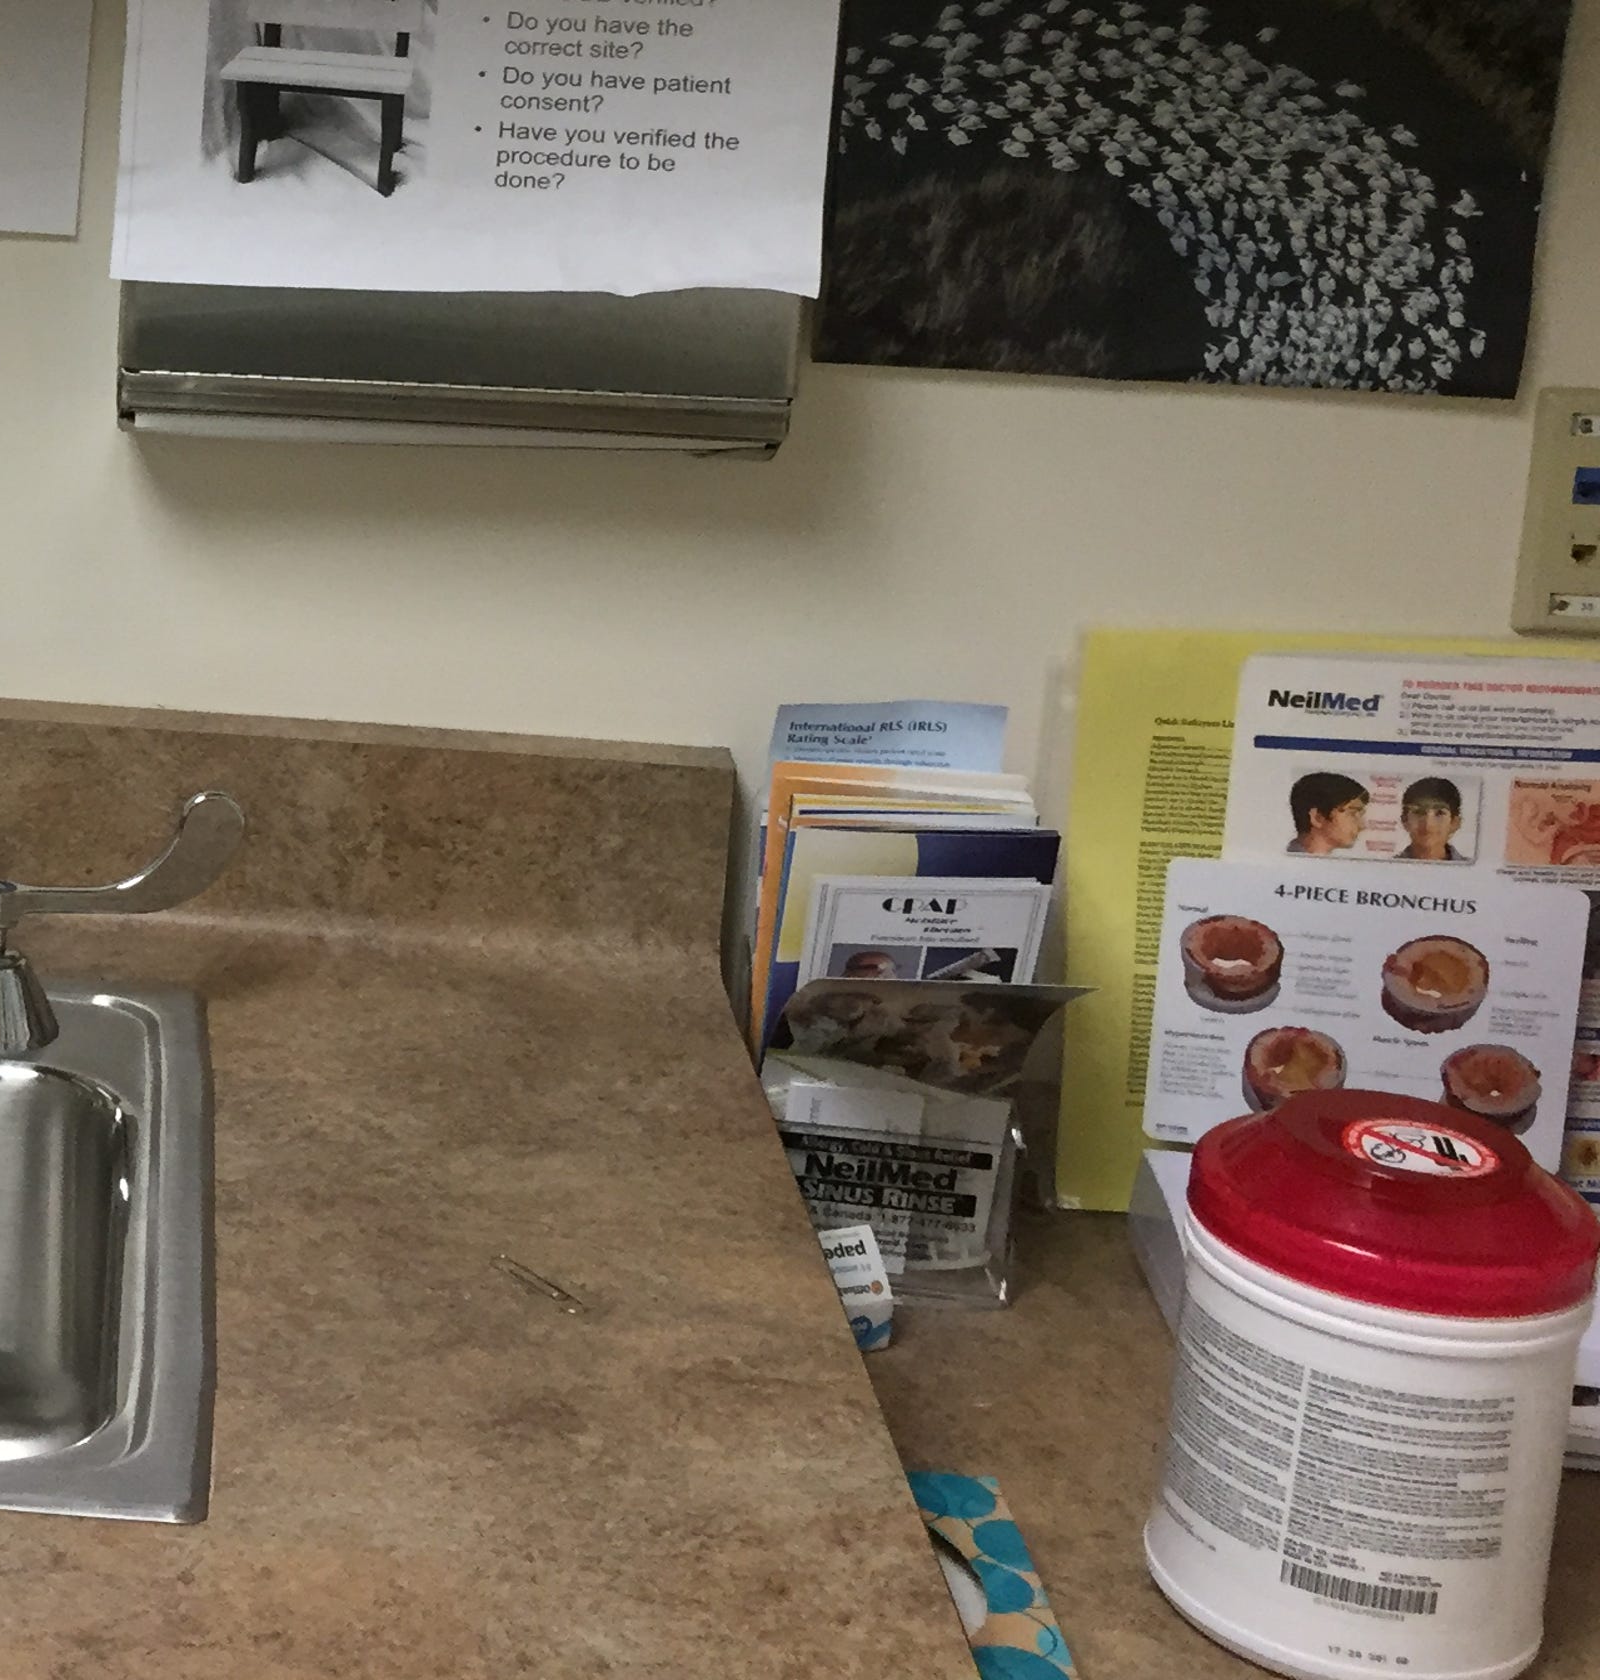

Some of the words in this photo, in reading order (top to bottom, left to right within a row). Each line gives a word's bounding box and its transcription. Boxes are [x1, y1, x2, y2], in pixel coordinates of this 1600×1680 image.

[507, 12, 538, 31] Do
[546, 17, 586, 35] you
[595, 16, 650, 35] have
[658, 19, 694, 37] the
[504, 40, 582, 57] correct
[590, 41, 644, 59] site?
[503, 67, 534, 85] Do
[542, 72, 582, 90] you
[591, 70, 645, 90] have
[653, 77, 731, 95] patient
[500, 94, 604, 113] consent?
[498, 121, 557, 142] Have
[565, 127, 606, 146] you
[614, 129, 696, 149] verified
[704, 131, 740, 151] the
[496, 150, 611, 169] procedure
[619, 153, 640, 171] to
[647, 153, 676, 172] be
[494, 171, 565, 190] done?
[1267, 689, 1381, 712] NeilMed
[789, 720, 875, 733] International
[879, 720, 904, 733] RLS
[908, 720, 948, 733] (IRLS)
[787, 733, 829, 748] Rating
[1274, 883, 1350, 905] 4-PIECE
[1355, 890, 1478, 915] BRONCHUS
[804, 1152, 958, 1192] NeilMed
[802, 1177, 875, 1204] SINUS
[882, 1187, 956, 1214] RINSE
